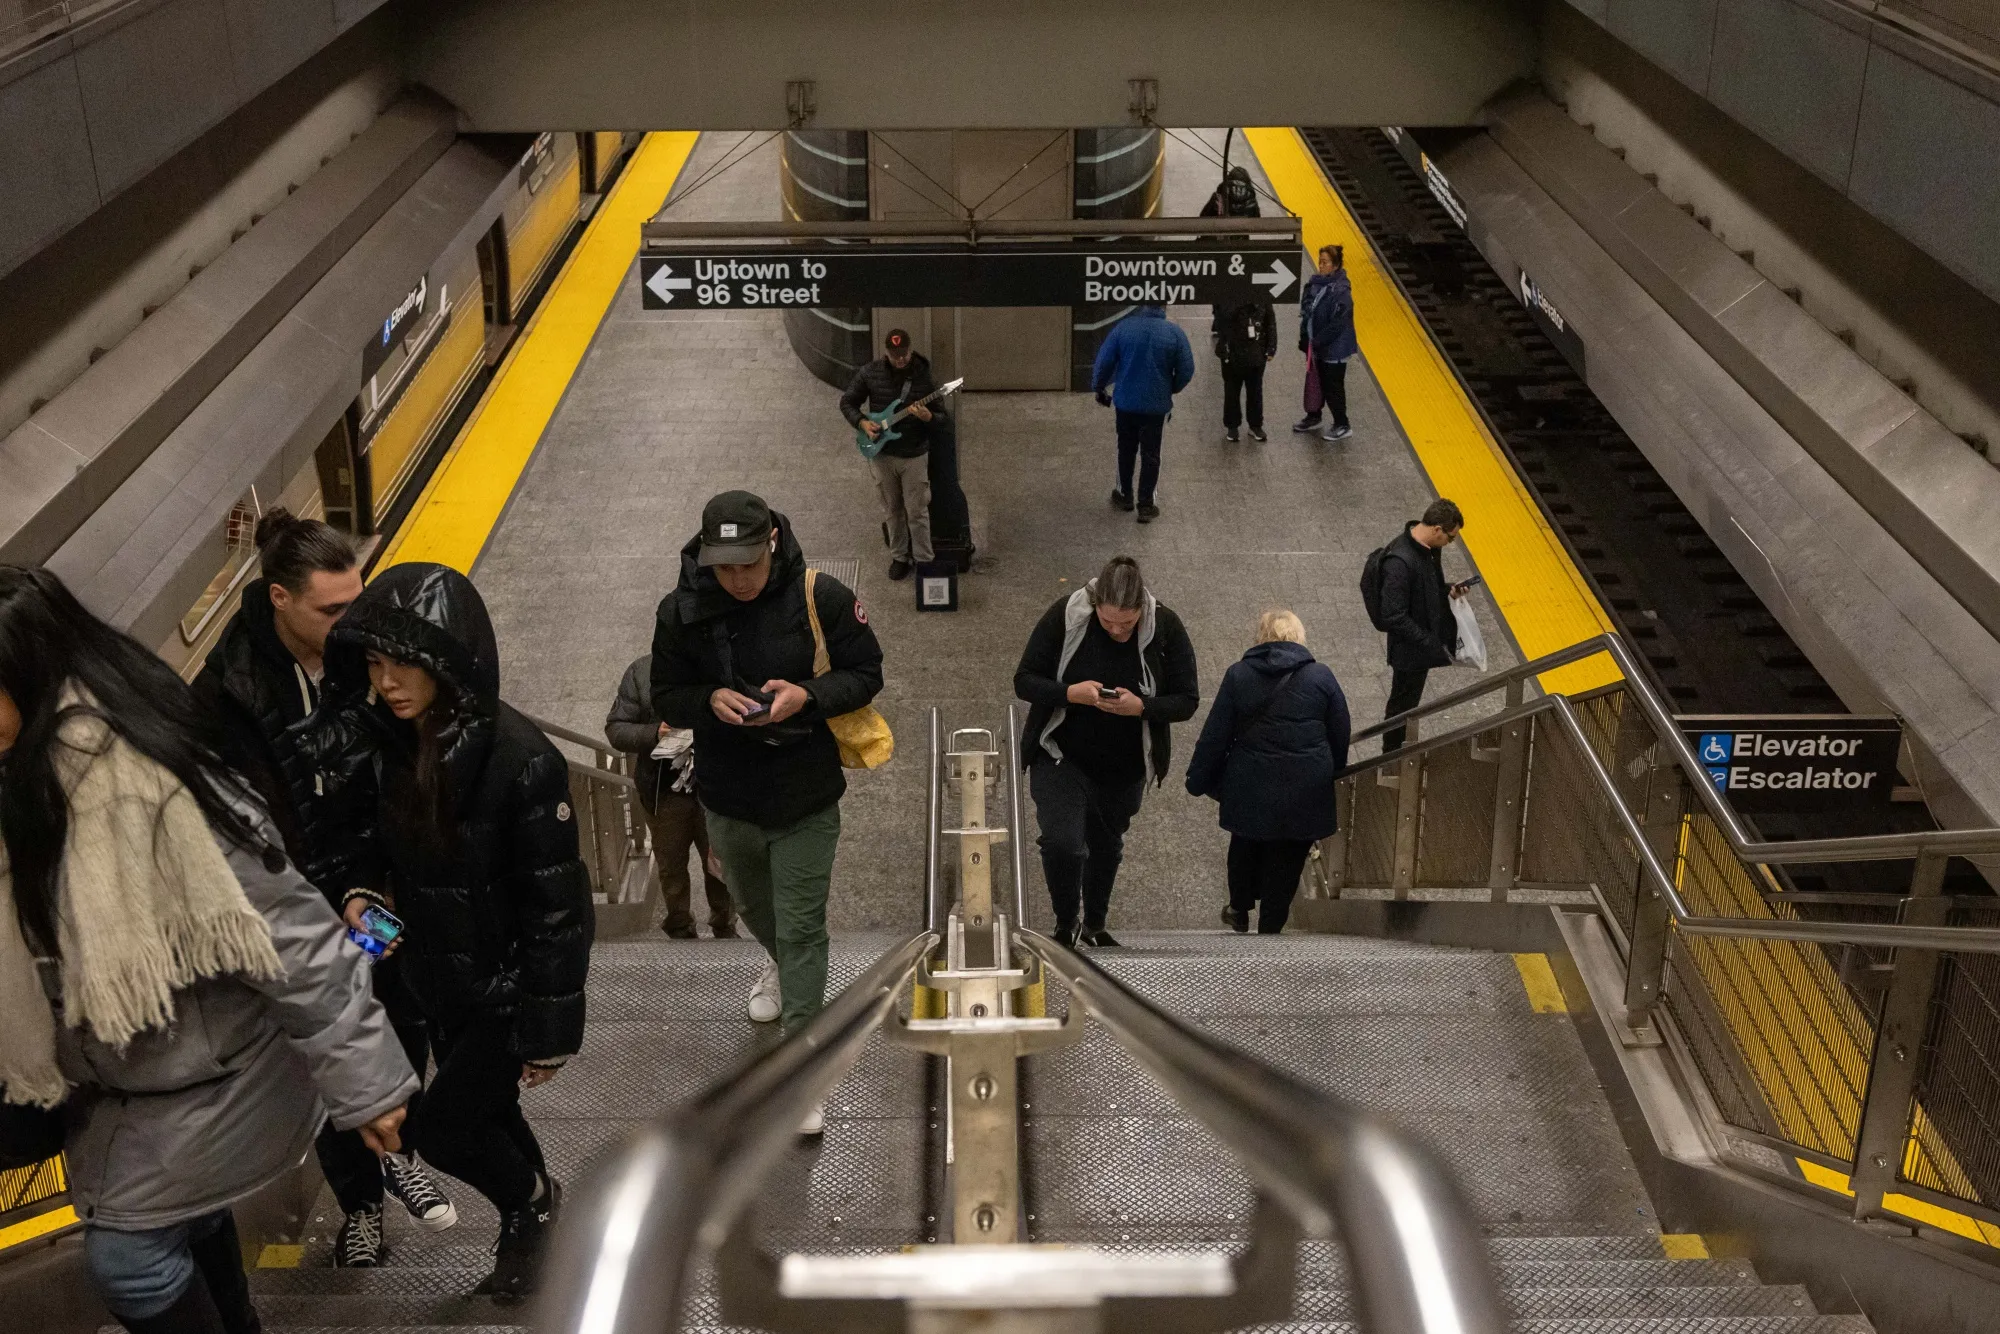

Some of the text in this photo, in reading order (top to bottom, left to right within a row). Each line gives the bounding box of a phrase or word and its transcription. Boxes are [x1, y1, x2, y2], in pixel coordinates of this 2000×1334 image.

[695, 259, 827, 284] Uptown to
[1085, 254, 1246, 277] Downtown &
[696, 283, 821, 305] 96 Street
[1085, 281, 1196, 305] Brooklyn
[391, 288, 418, 332] Elevator
[1537, 288, 1564, 333] Elevator
[1732, 734, 1863, 757] Elevator
[1728, 766, 1878, 790] Escalator
